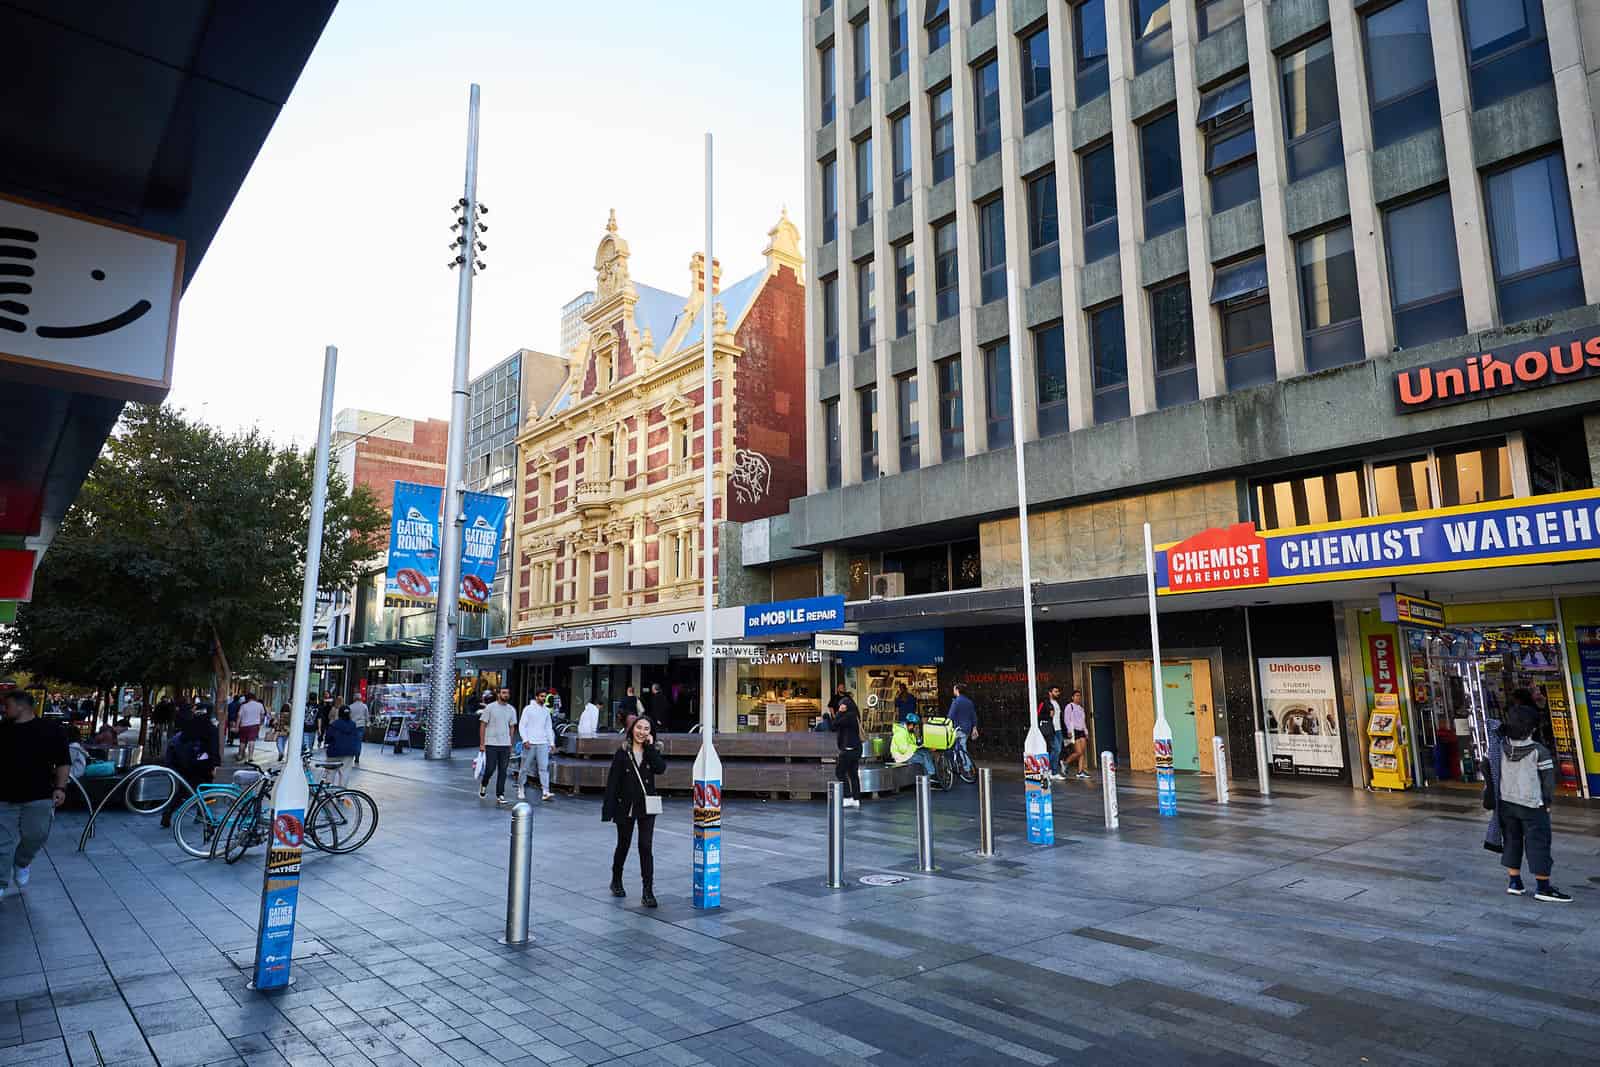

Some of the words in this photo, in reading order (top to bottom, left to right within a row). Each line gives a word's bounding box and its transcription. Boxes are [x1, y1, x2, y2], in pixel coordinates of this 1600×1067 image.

[396, 519, 434, 538] GATHER
[465, 527, 498, 546] GATHER
[396, 534, 434, 551] ROUND
[1279, 526, 1425, 570] CHEMIST
[1442, 507, 1600, 553] WAREH
[1171, 543, 1261, 572] CHEMIST
[1173, 566, 1260, 585] WAREHOUSE
[748, 617, 760, 627] DR
[806, 609, 837, 621] REPAIR
[1269, 663, 1322, 673] Unihouse
[1374, 640, 1391, 680] OPEN
